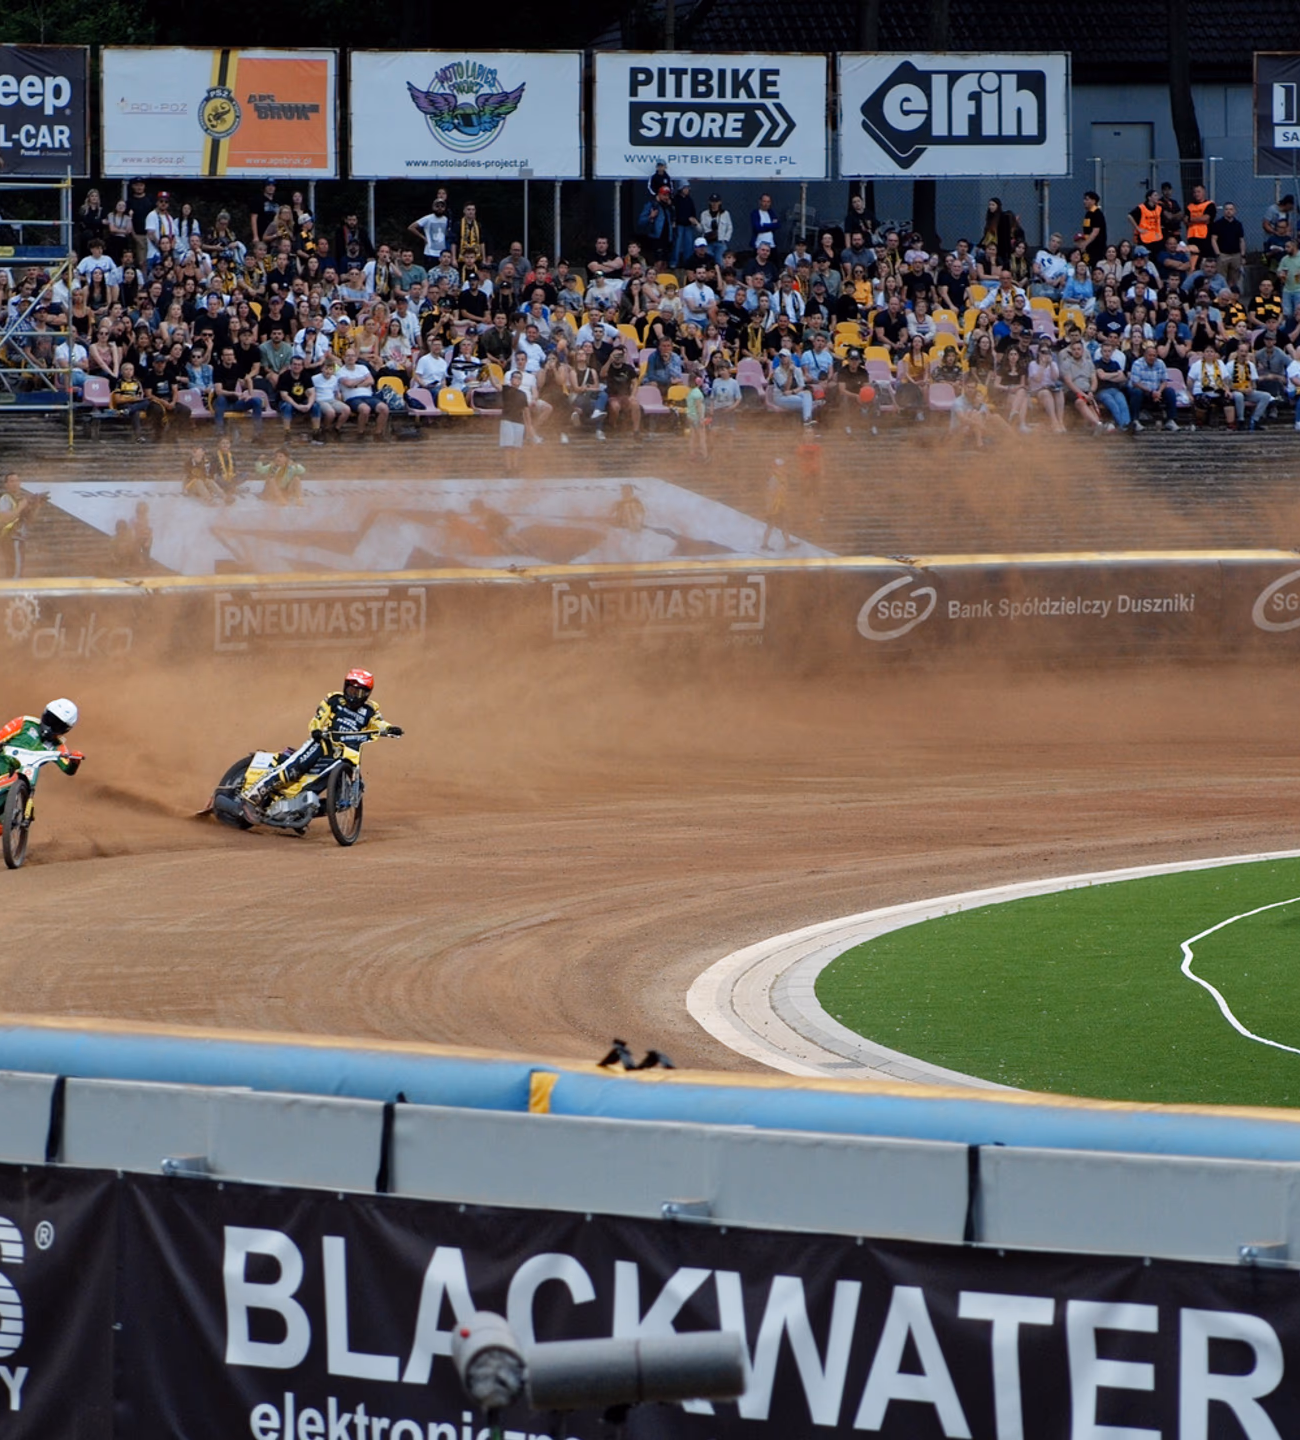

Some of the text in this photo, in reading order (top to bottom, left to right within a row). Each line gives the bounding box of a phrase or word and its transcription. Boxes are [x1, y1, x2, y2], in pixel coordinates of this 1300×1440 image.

[629, 66, 780, 99] PITBIKE
[638, 111, 745, 138] STORE
[405, 159, 529, 169] www.motoladies-project.pl
[624, 154, 797, 165] WWWPITBIKESTORE.PL
[224, 601, 417, 637] PNEUMASTER
[562, 587, 758, 625] PNEUMASTER
[877, 594, 1196, 619] SGB Bank Spółdzielczy Duszniki
[223, 1226, 1285, 1440] BLACKWATER
